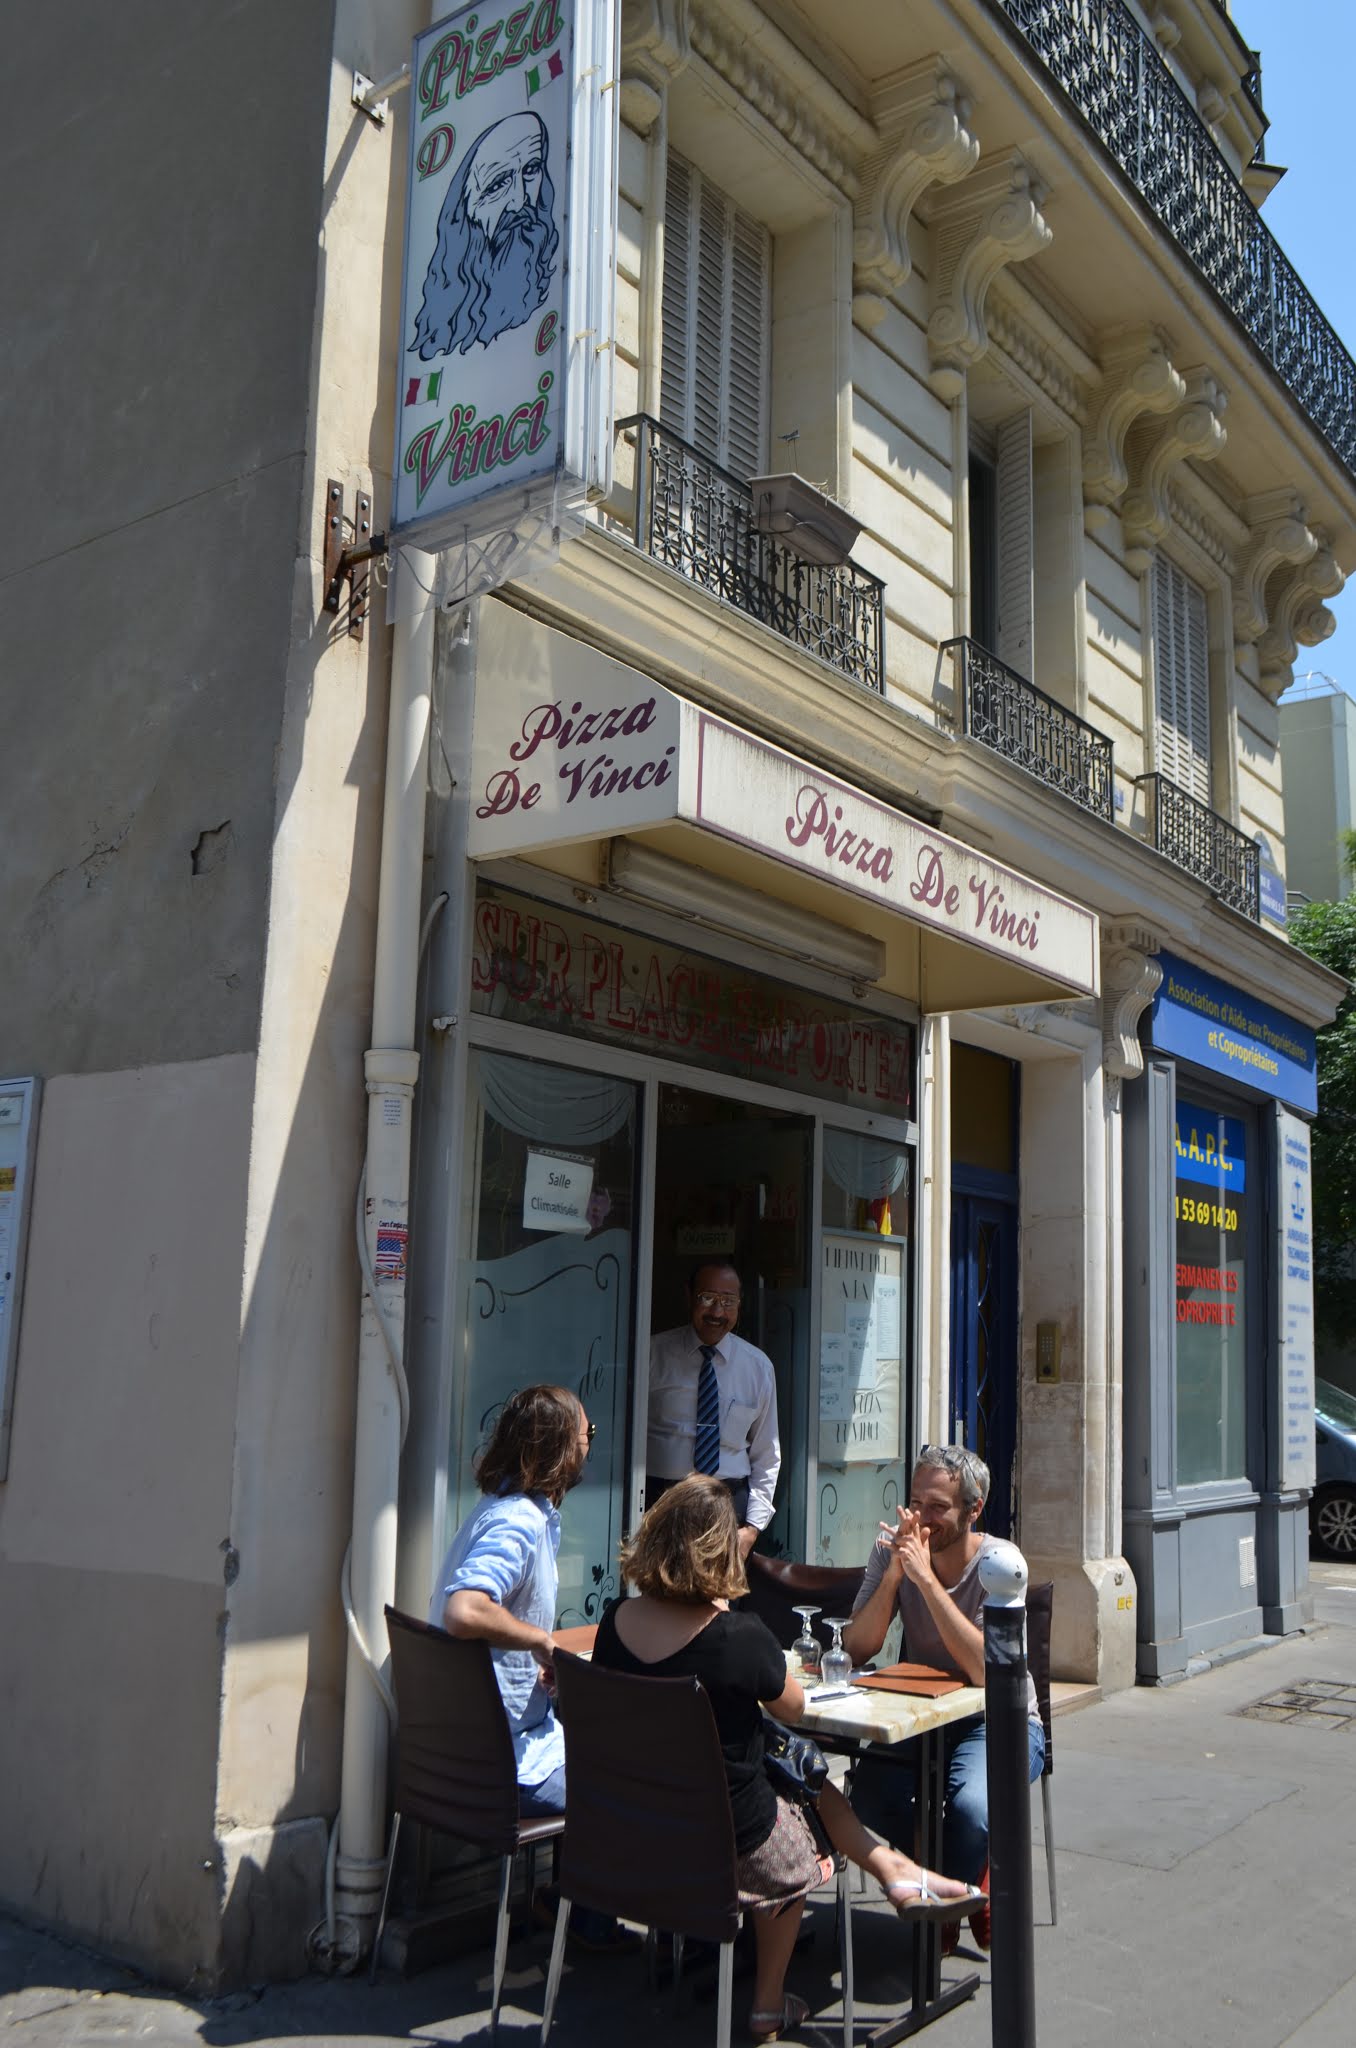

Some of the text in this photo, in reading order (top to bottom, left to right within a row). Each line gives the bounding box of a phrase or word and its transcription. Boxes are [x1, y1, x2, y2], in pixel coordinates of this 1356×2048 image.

[419, 0, 565, 122] Pizza
[404, 370, 552, 510] Vinci
[510, 697, 657, 762] Pizza
[476, 746, 676, 819] De Vinci
[785, 784, 1040, 951] Pizza De Vinci
[471, 900, 574, 1012] SUR
[1168, 977, 1307, 1063] Association d'Aide aux Propriétaires
[1208, 1030, 1279, 1076] et Copropriétaires
[531, 1196, 580, 1218] Climatisée
[548, 1172, 571, 1189] Salle
[1182, 1198, 1195, 1222] 53
[1197, 1201, 1210, 1225] 69
[1211, 1205, 1223, 1228] 14
[1225, 1208, 1238, 1231] 20
